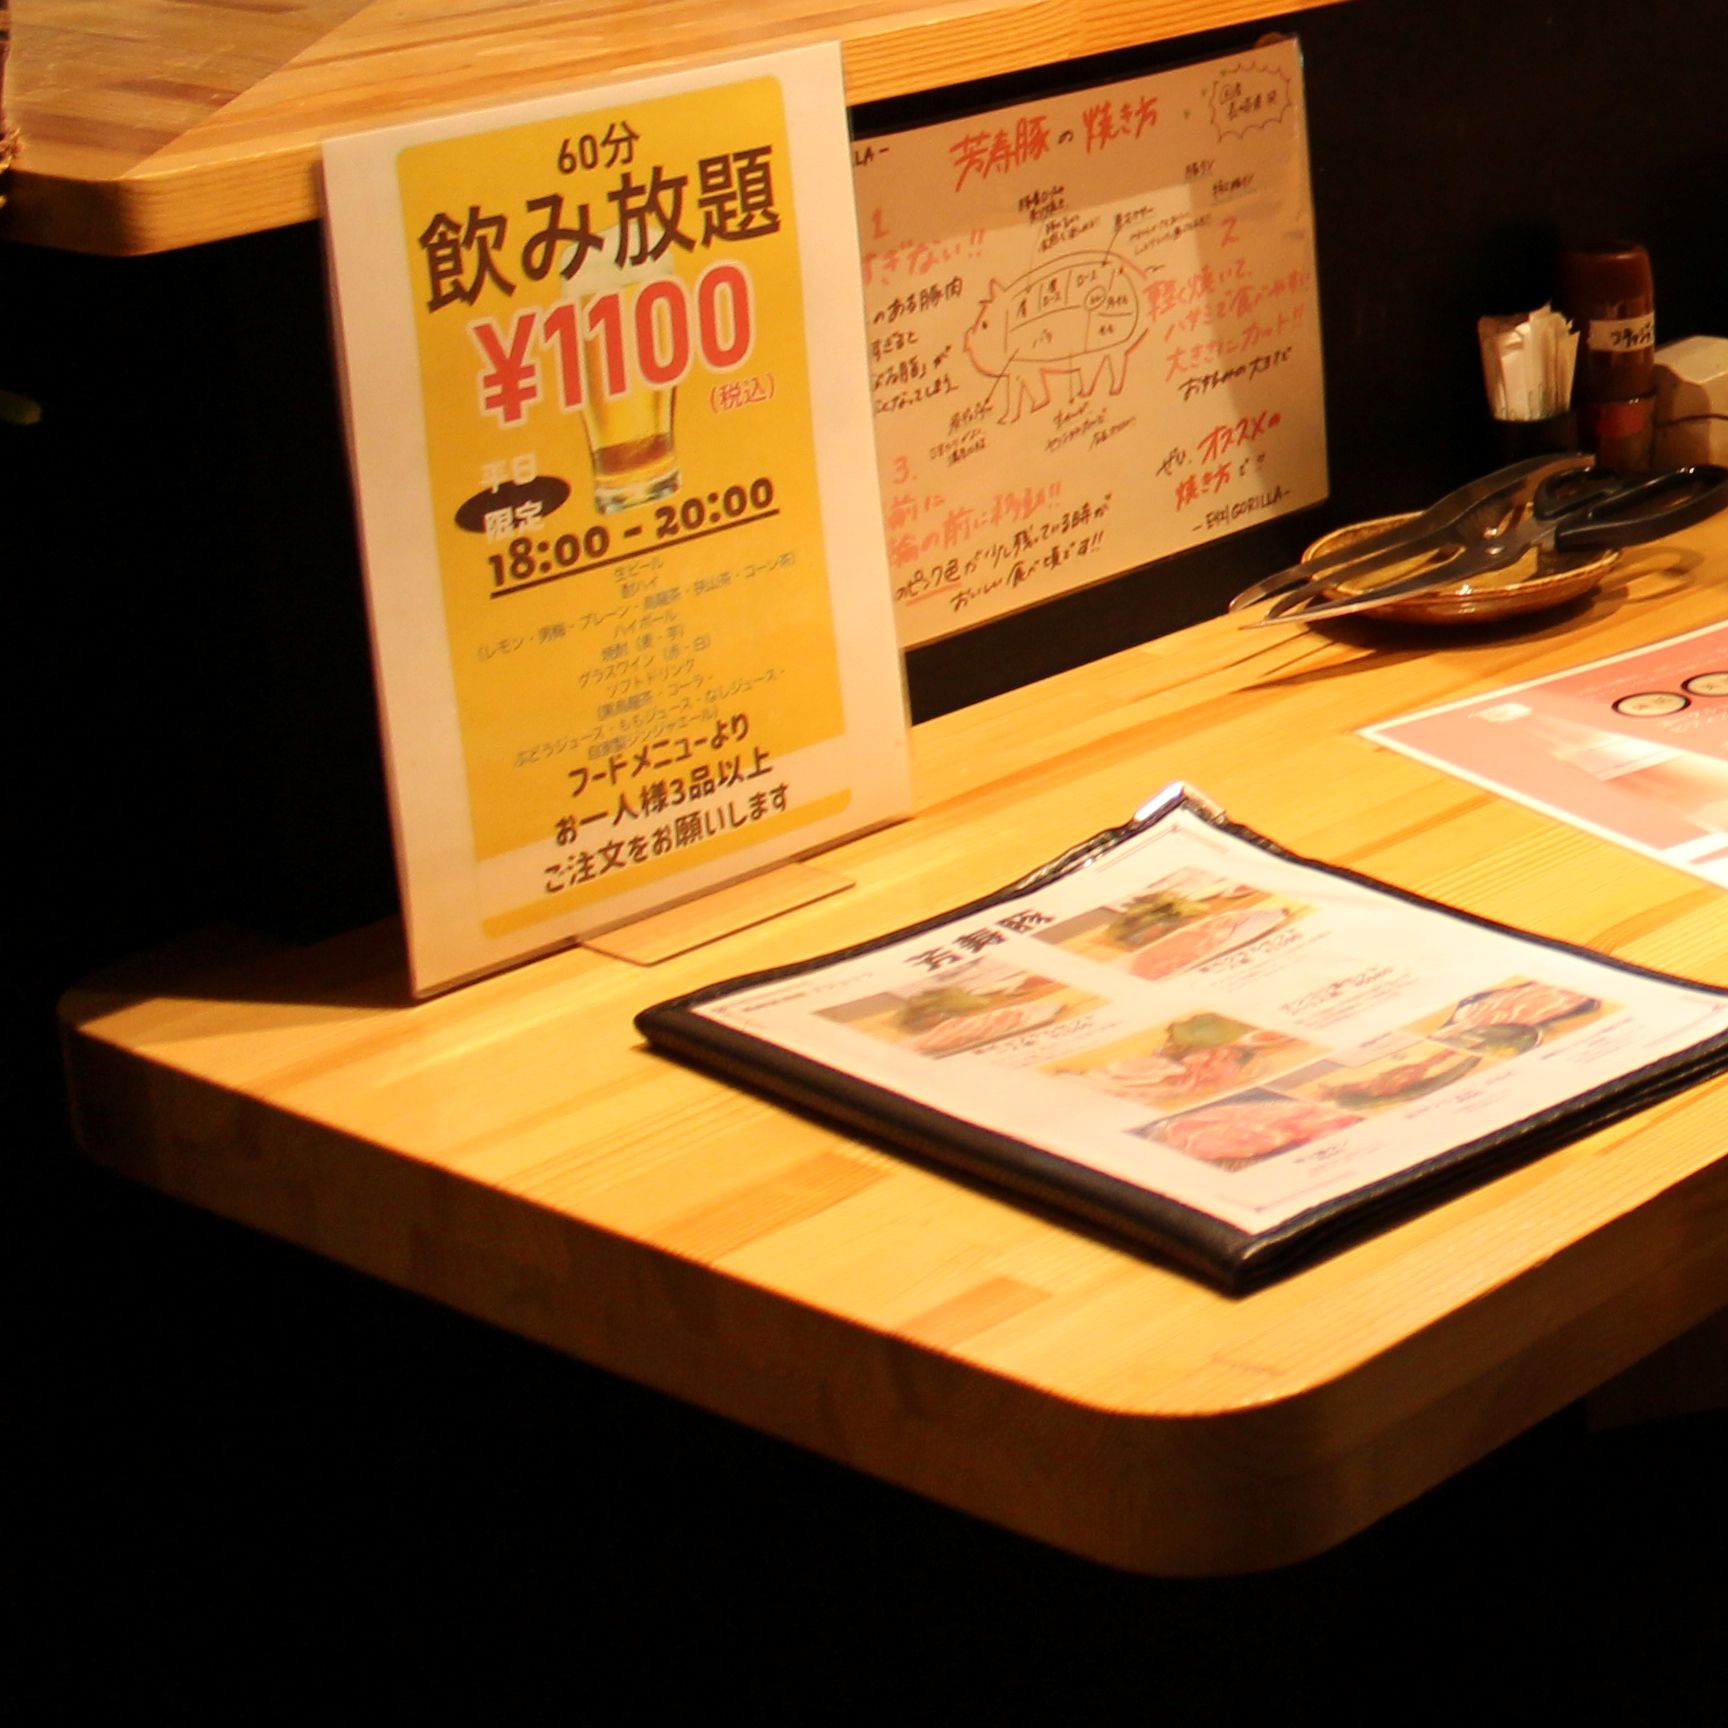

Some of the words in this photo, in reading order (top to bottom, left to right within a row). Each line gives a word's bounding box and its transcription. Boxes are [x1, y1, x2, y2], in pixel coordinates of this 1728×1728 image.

[557, 120, 640, 174] 60分
[418, 145, 782, 314] 飲み放題
[473, 263, 753, 424] ¥1100
[710, 373, 776, 413] (税込)
[488, 523, 611, 588] 18:00
[655, 477, 775, 536] 20:00
[555, 748, 774, 847] お一人様3品以上
[568, 712, 749, 797] フードメニューより
[543, 782, 790, 895] ご注文をお願いします
